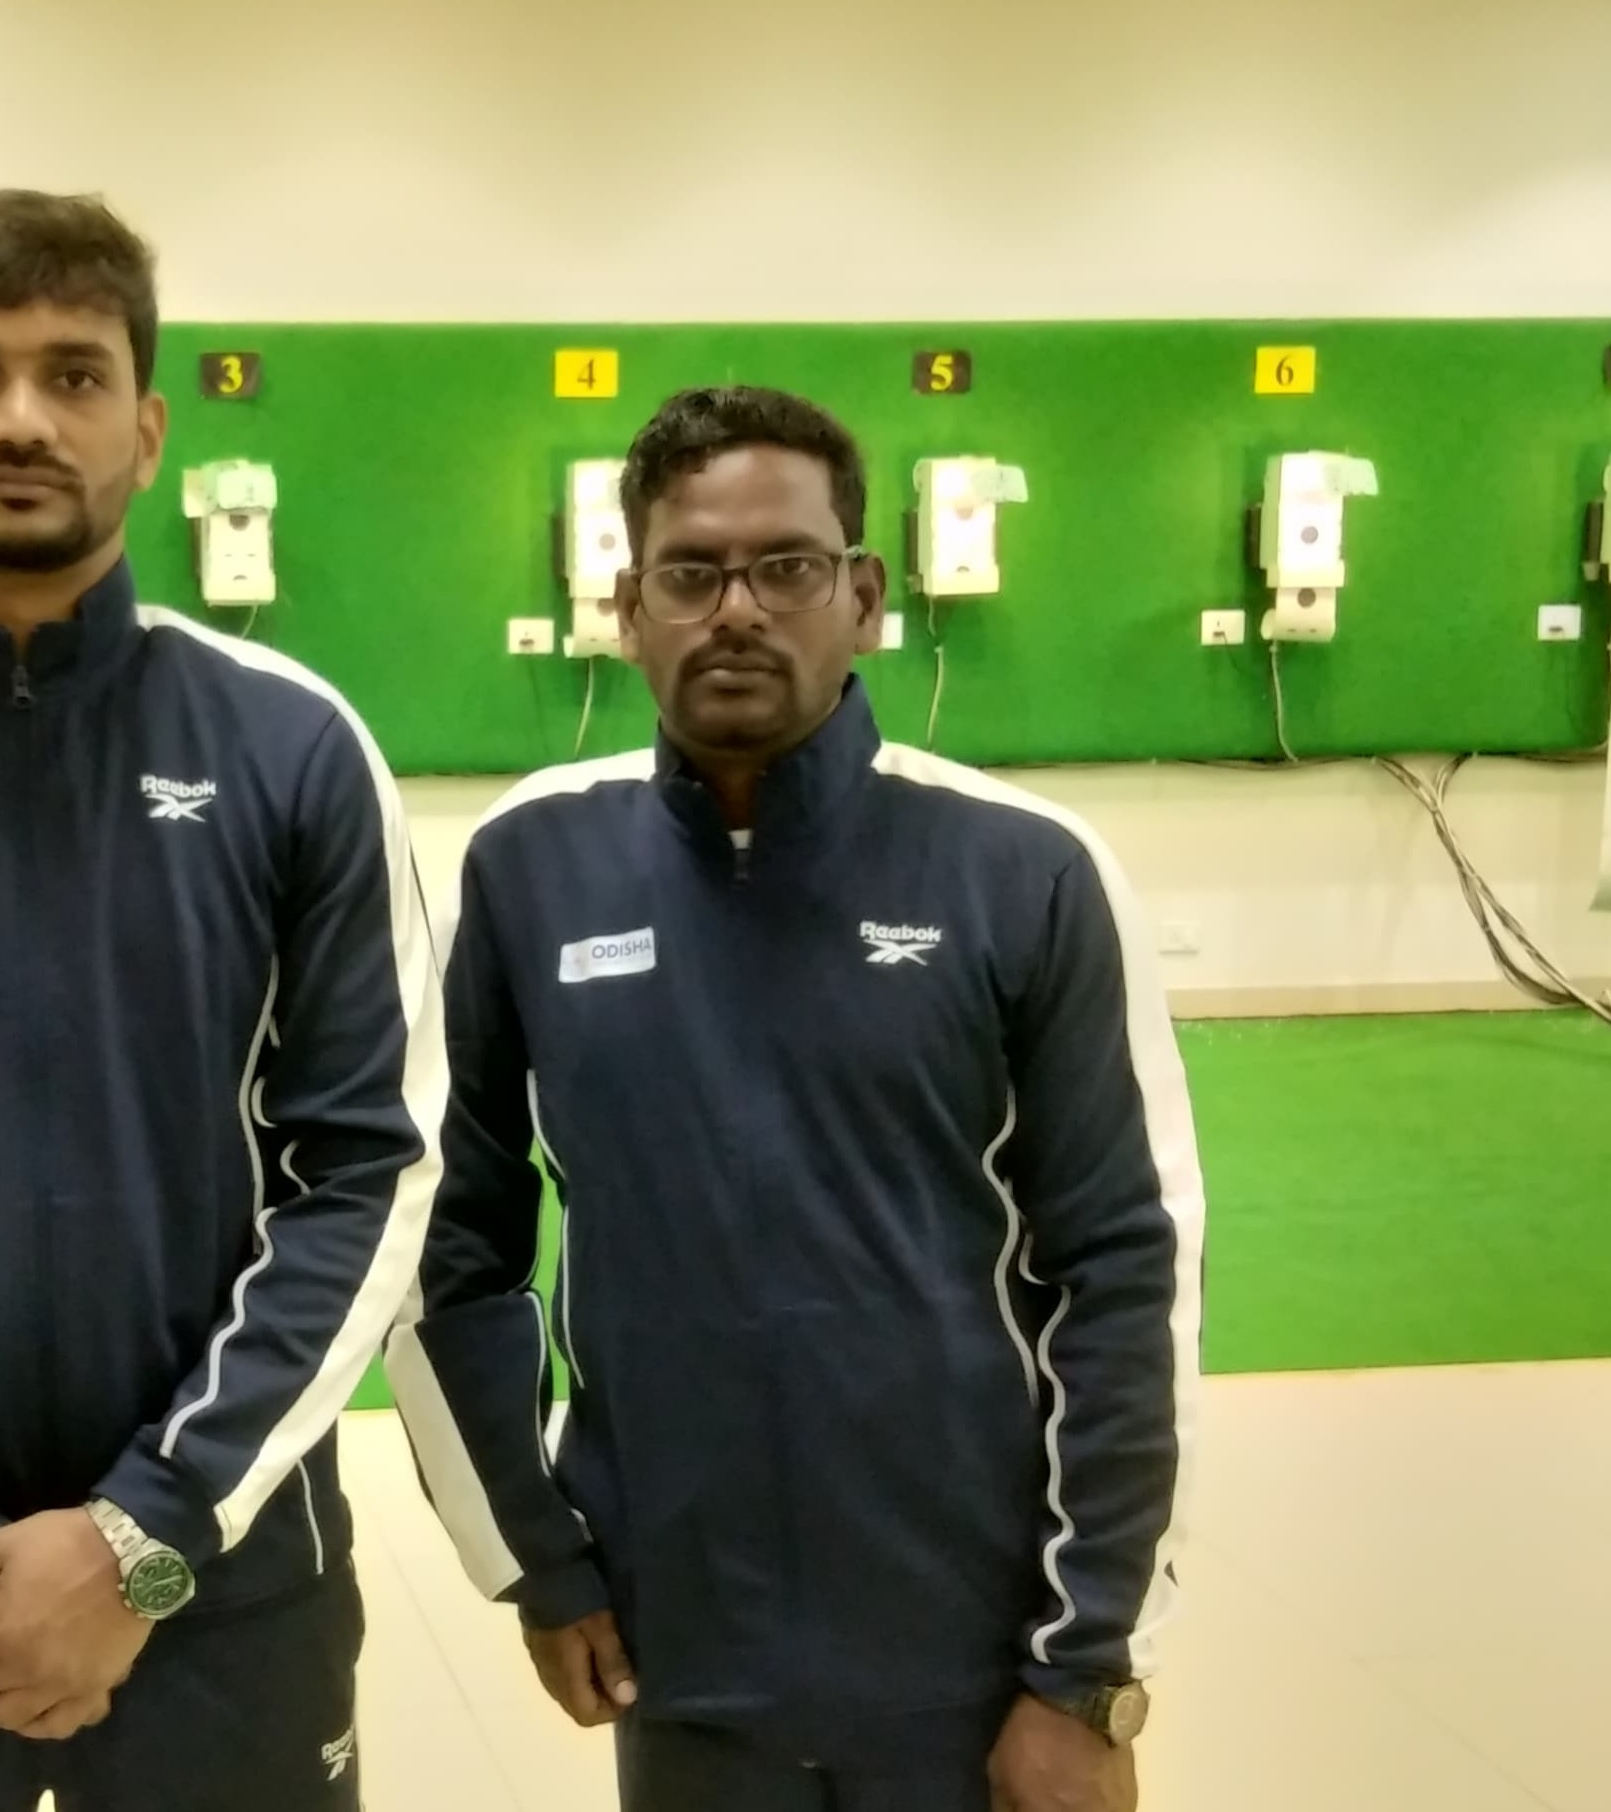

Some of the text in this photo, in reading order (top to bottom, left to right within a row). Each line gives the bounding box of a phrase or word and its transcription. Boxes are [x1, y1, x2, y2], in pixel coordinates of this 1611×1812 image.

[219, 355, 243, 394] 3
[576, 358, 597, 391] 4
[931, 354, 953, 392] 5
[1275, 354, 1294, 387] 6
[140, 774, 217, 799] Reebok
[859, 920, 942, 943] Reebok
[591, 937, 652, 960] ODISHA
